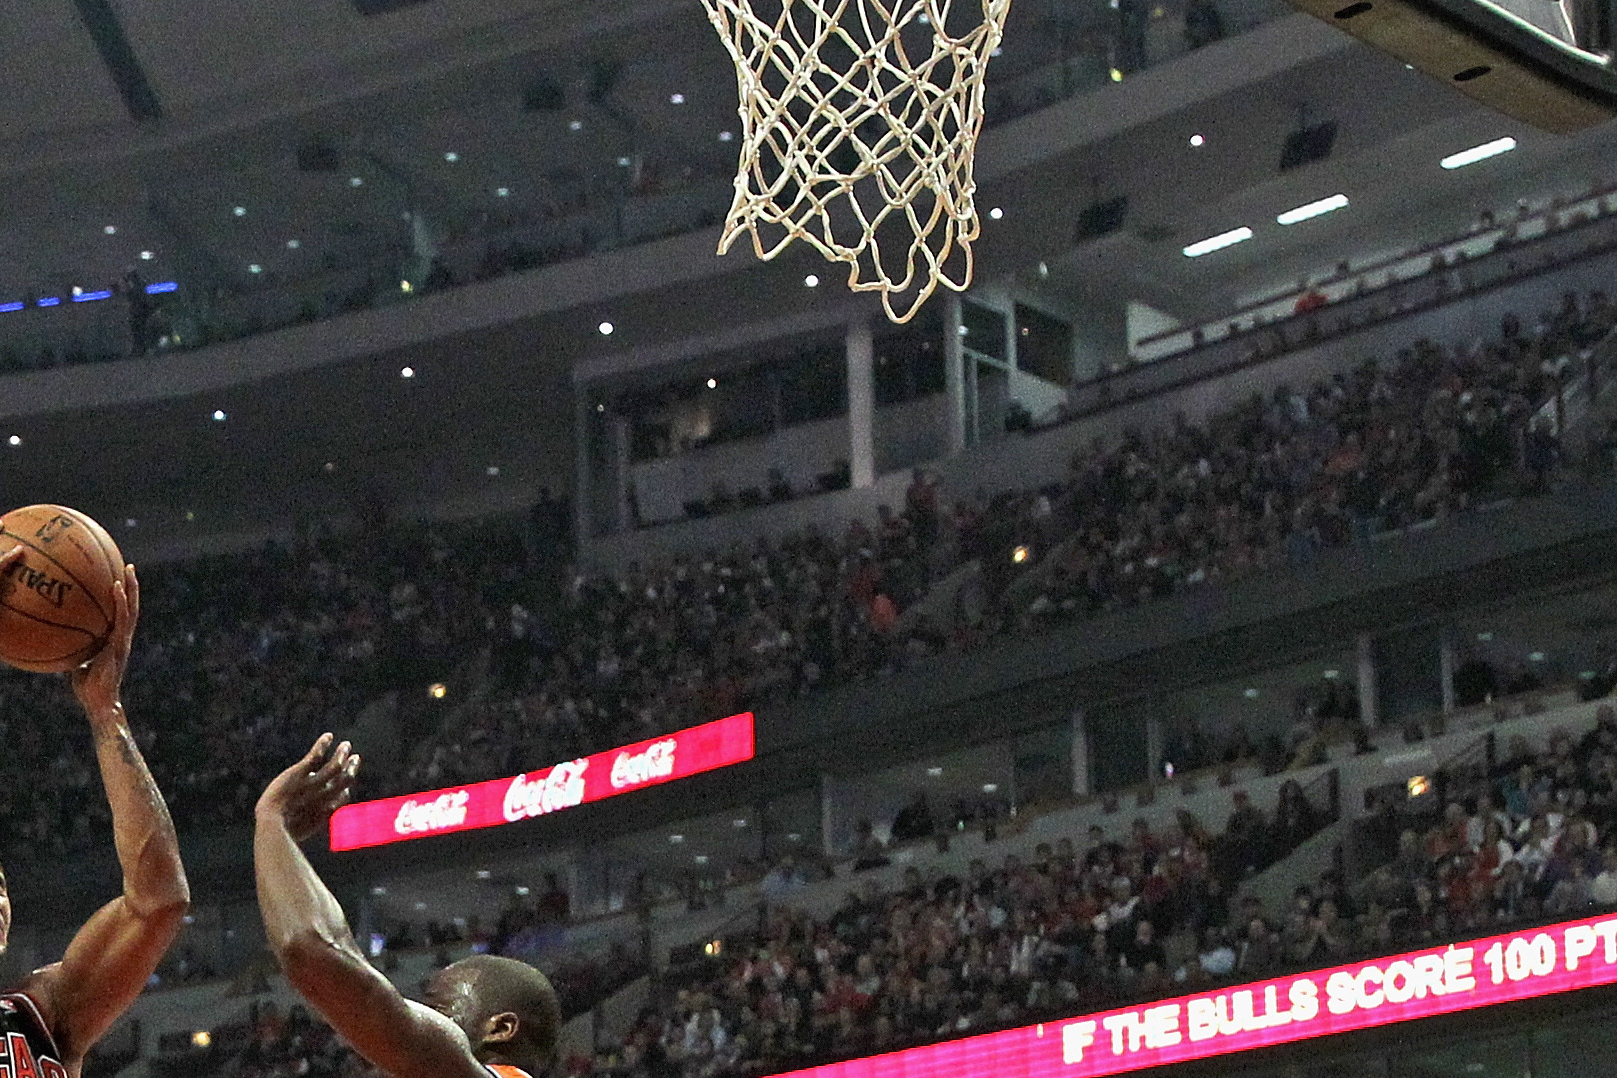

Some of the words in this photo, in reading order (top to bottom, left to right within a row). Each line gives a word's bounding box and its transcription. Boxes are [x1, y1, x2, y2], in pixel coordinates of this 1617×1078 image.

[1102, 1003, 1182, 1055] THE
[1187, 985, 1319, 1042] BULLS
[1326, 946, 1477, 1014] SCORE
[1484, 933, 1556, 985] 100
